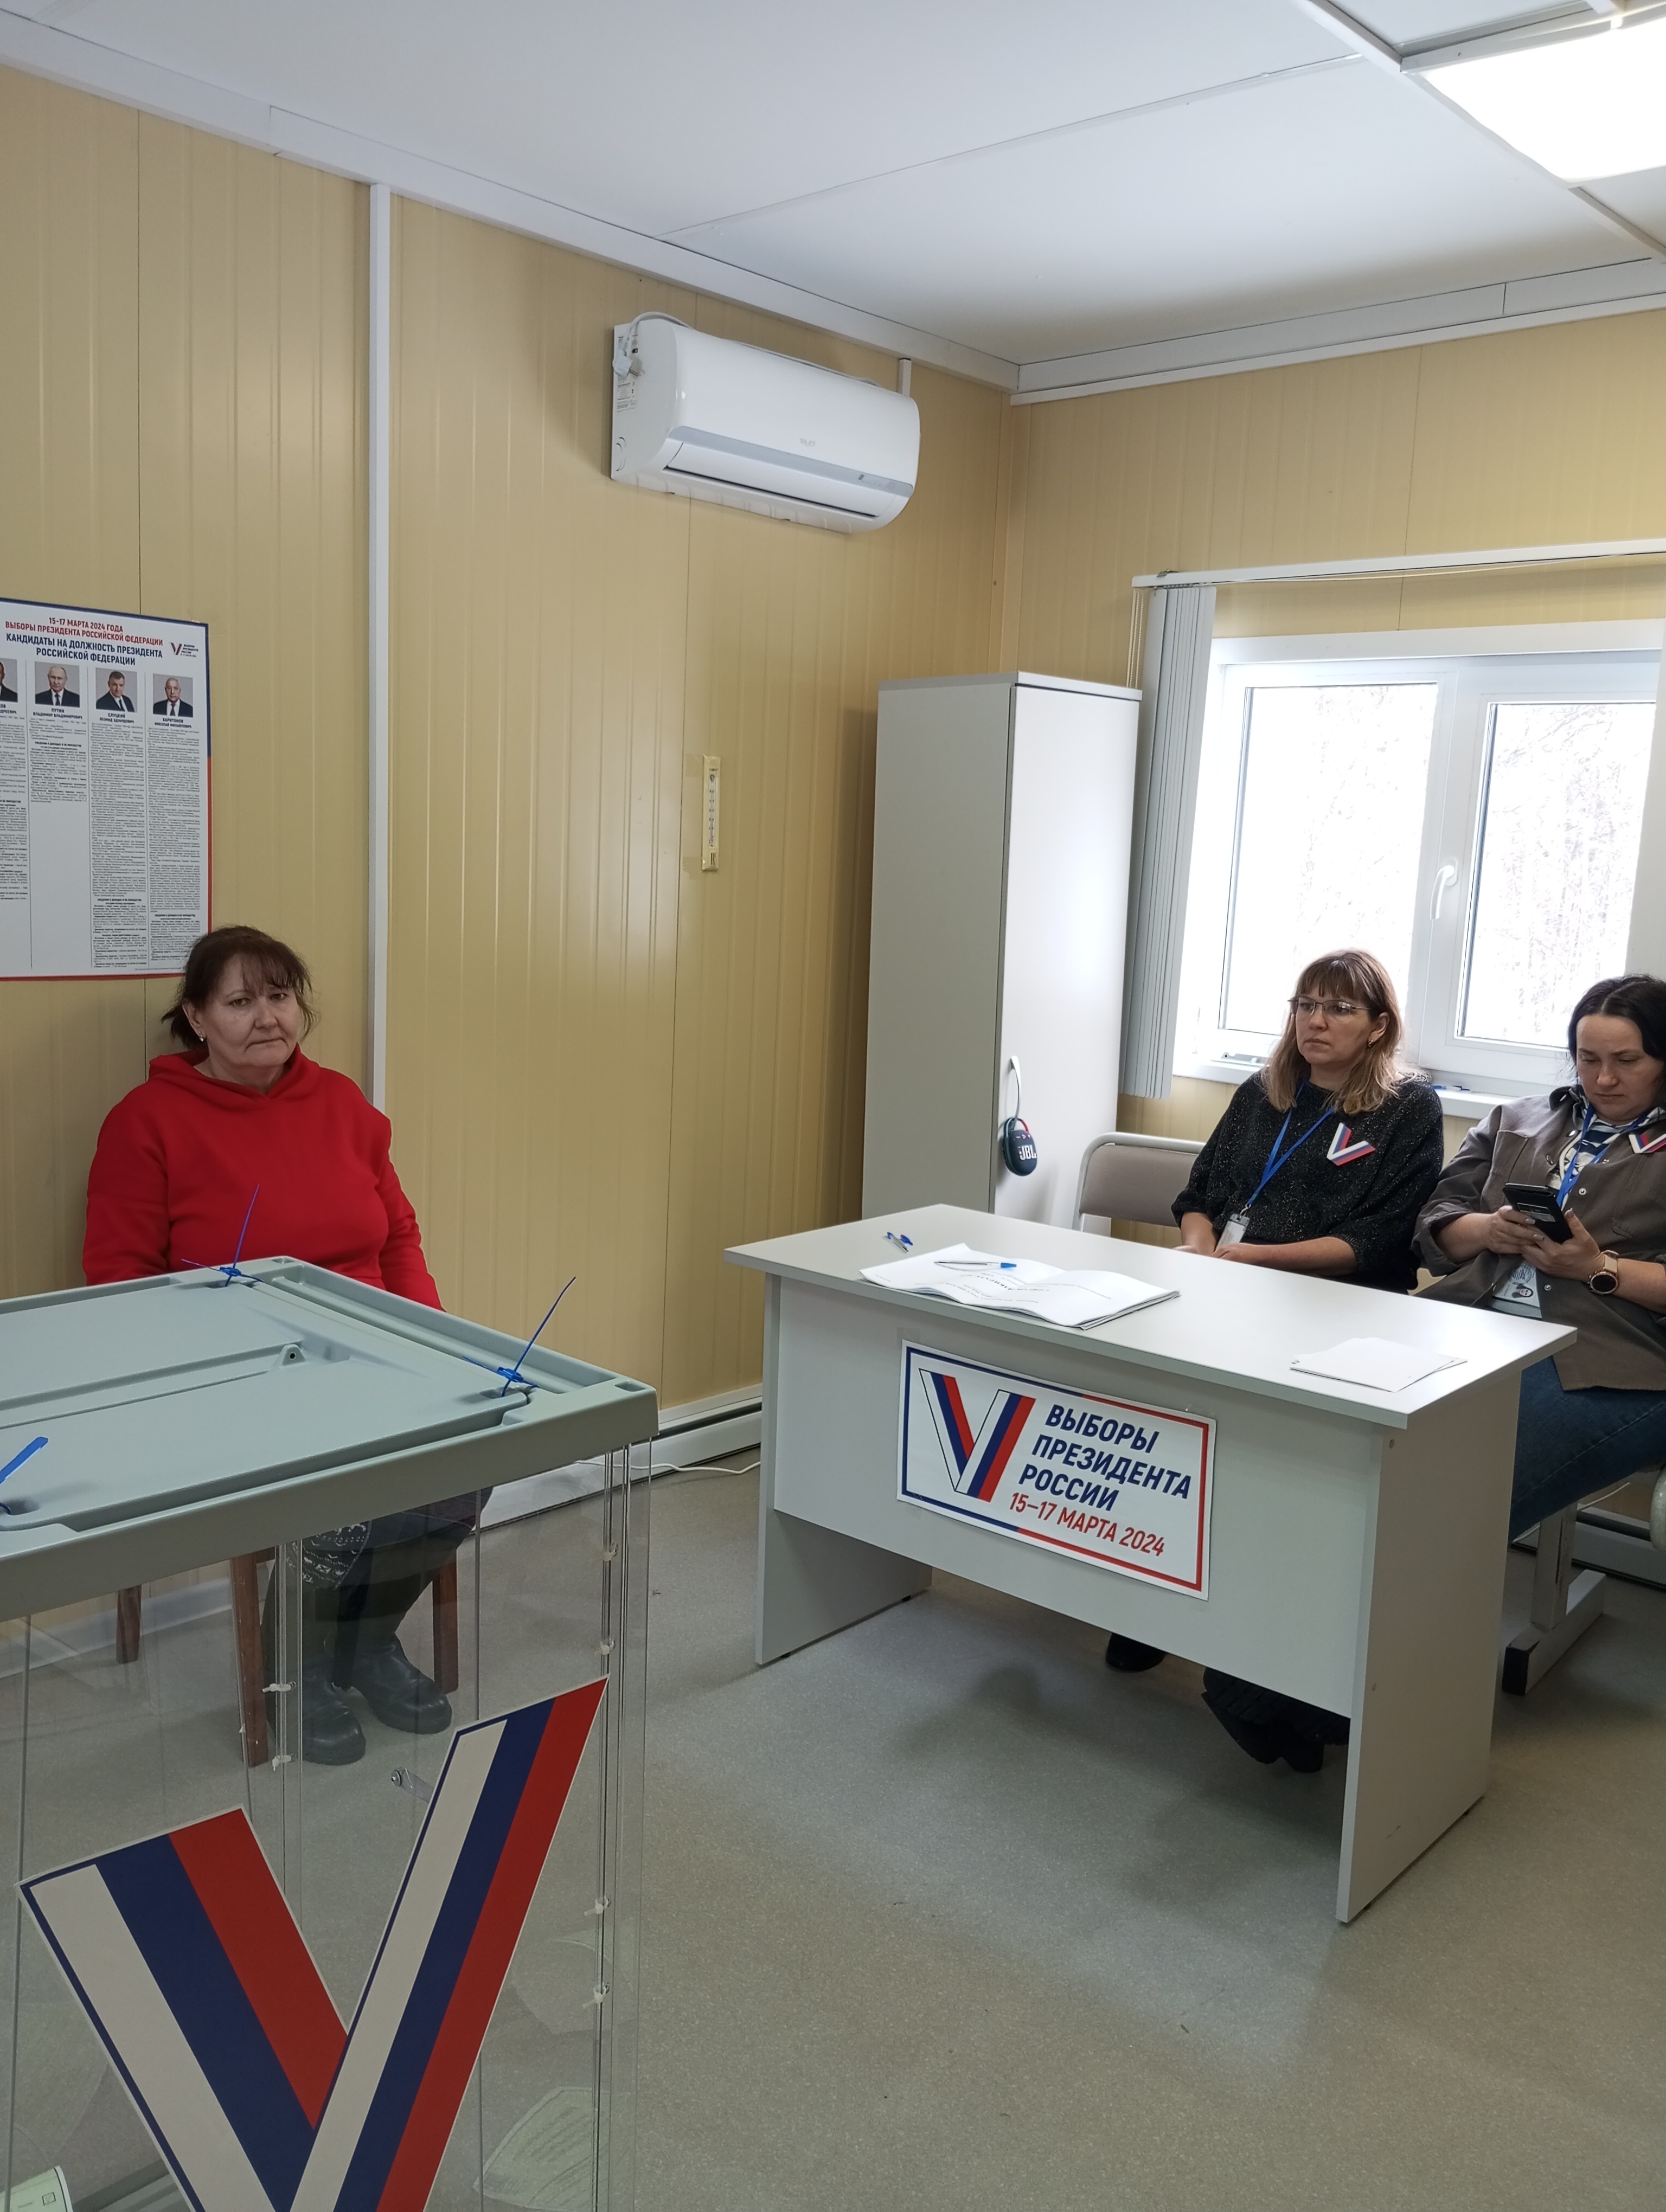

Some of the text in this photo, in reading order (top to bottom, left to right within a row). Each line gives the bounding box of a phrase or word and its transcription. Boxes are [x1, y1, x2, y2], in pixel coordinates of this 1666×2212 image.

[5, 621, 163, 646] ВЫБОРЫ ПРЕЗИДЕНТА РОССИЙСКОЙ ФЕДЕРАЦИИ
[67, 619, 89, 628] МАРТА
[90, 622, 105, 630] 2024
[106, 624, 123, 633] ГОДА
[6, 633, 163, 658] КАНДИДАТЫ НА ДОЛЖНОСТЬ ПРЕЗИДЕНТА
[36, 647, 136, 666] РОССИЙСКОЙ ФЕДЕРАЦИИ
[1018, 1144, 1036, 1161] JBL
[1045, 1404, 1160, 1454] ВЫБОРЫ
[1031, 1433, 1191, 1500] ПРЕЗИДЕНТА
[1018, 1463, 1120, 1512] РОССИИ
[1056, 1506, 1117, 1542] МАРТА
[1118, 1526, 1165, 1557] 2024
